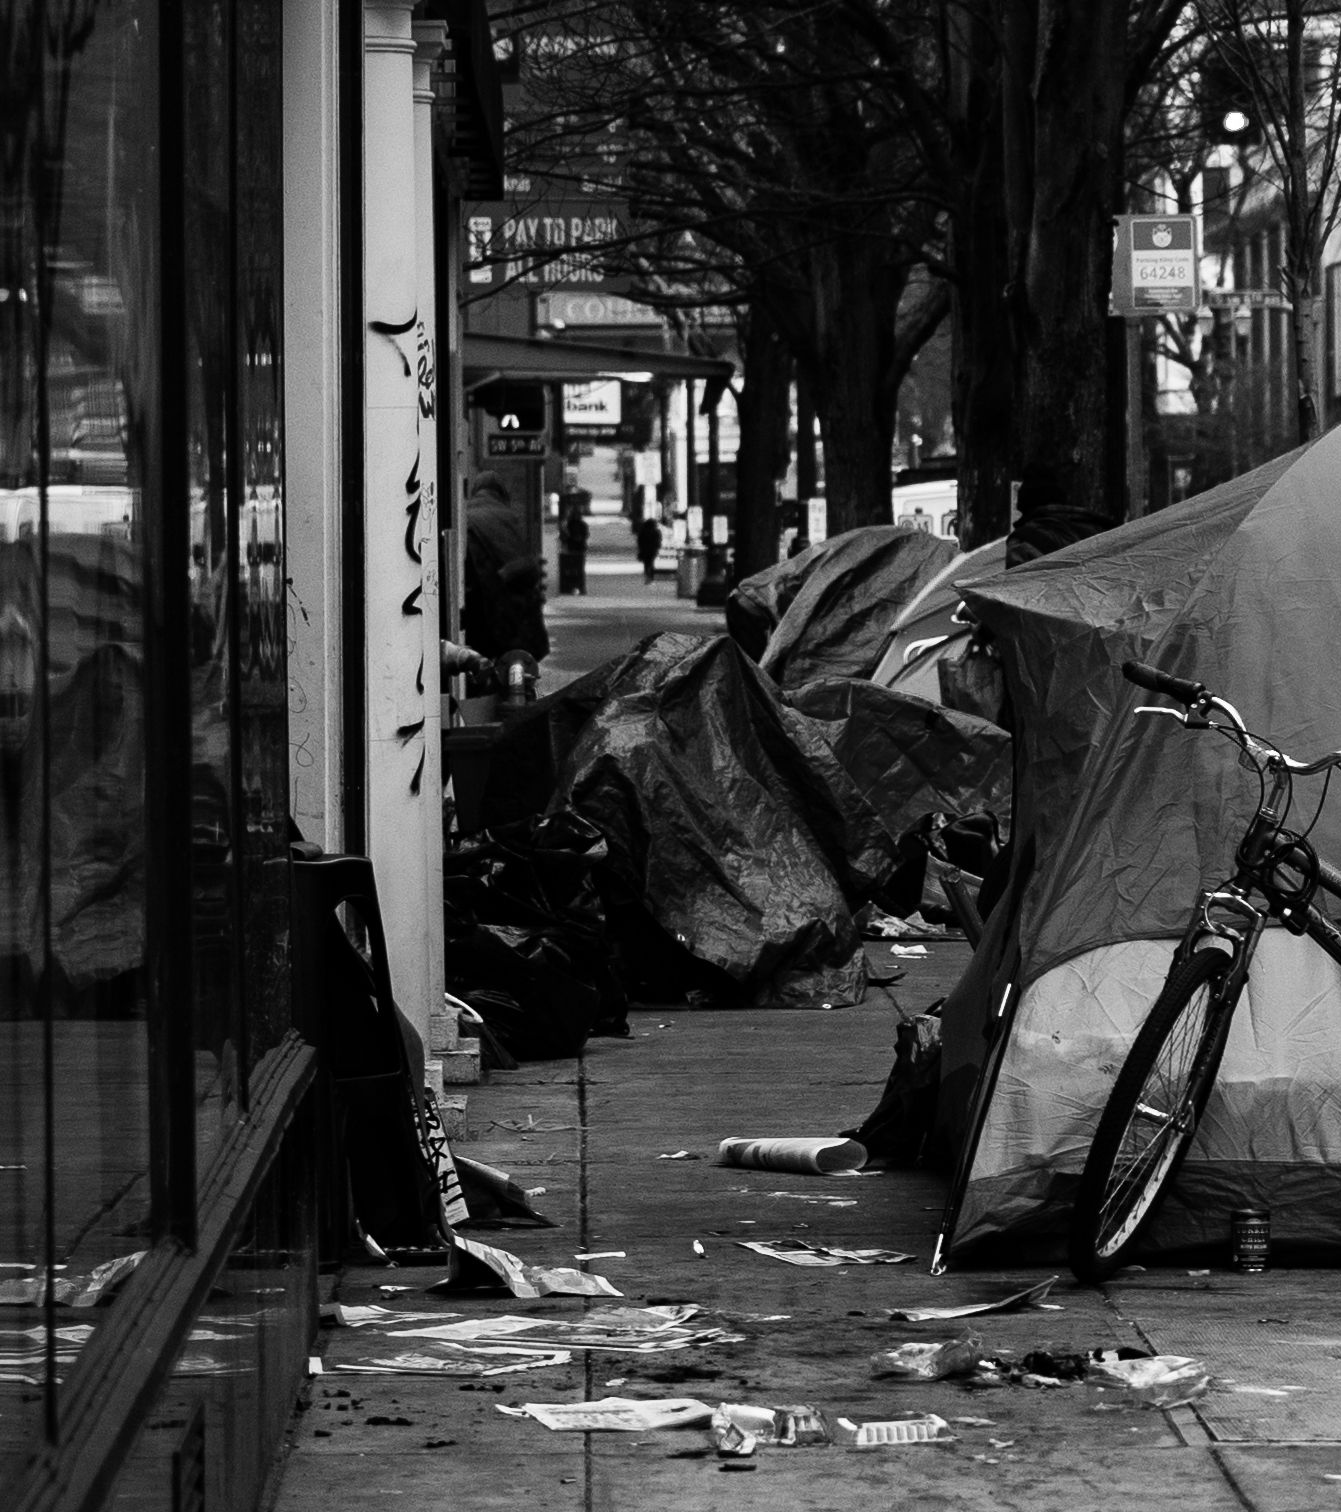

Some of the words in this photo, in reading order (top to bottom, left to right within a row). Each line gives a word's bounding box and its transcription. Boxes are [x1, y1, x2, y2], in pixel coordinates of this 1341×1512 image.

[503, 218, 539, 247] PAY
[1140, 266, 1186, 280] 64248
[566, 400, 608, 412] bank
